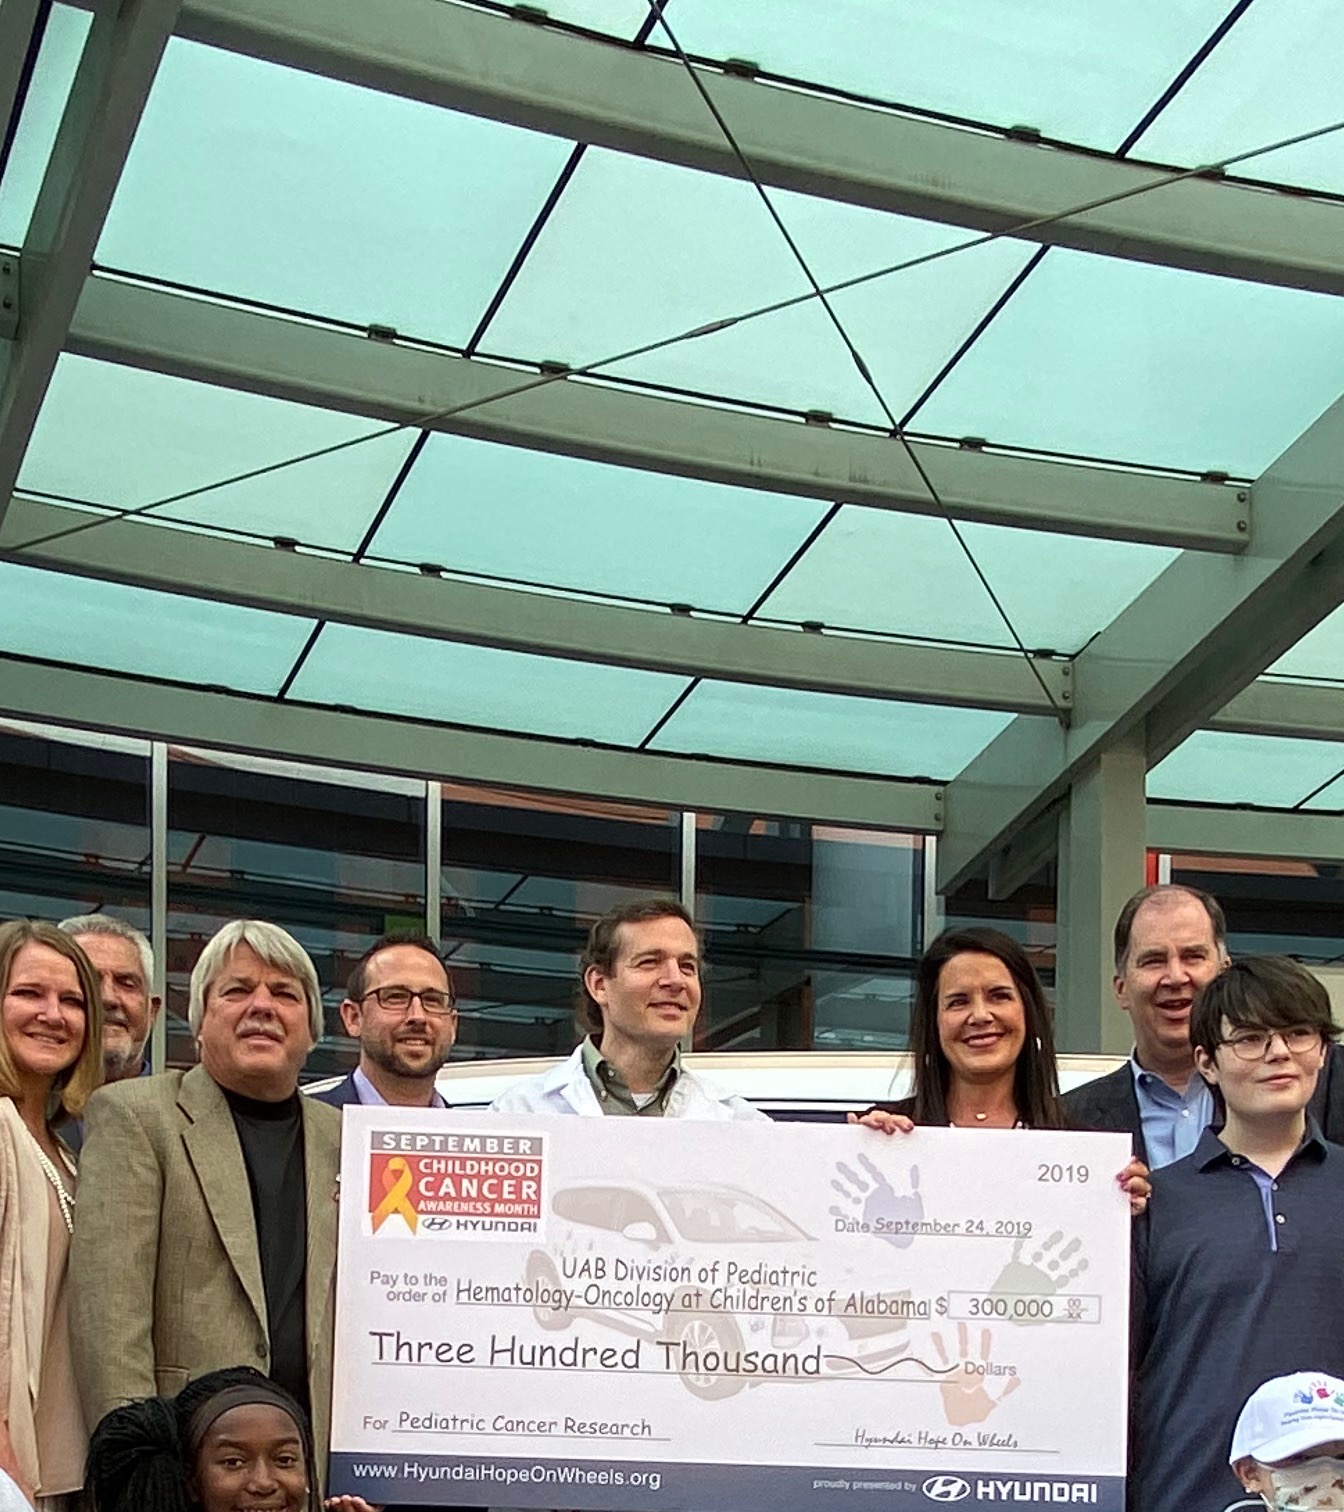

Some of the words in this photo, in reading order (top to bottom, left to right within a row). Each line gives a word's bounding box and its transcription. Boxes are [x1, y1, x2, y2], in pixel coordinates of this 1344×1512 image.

[382, 1134, 533, 1155] SEPTEMBER
[418, 1157, 539, 1178] CHILDHOOD
[1036, 1164, 1090, 1184] 2019
[418, 1177, 538, 1200] CANCER
[417, 1199, 492, 1214] AWARENESS
[493, 1201, 538, 1216] MONTH
[455, 1218, 538, 1234] HYUNDAI
[834, 1218, 870, 1234] Date
[874, 1218, 960, 1236] September
[964, 1219, 990, 1236] 24,
[994, 1220, 1033, 1237] 2019
[369, 1270, 400, 1290] Pay
[403, 1272, 420, 1287] to
[423, 1273, 449, 1288] the
[562, 1257, 608, 1280] UAB
[614, 1258, 691, 1284] Division
[697, 1260, 720, 1285] of
[726, 1262, 818, 1288] Pediatric
[386, 1288, 429, 1303] order
[432, 1289, 449, 1303] of
[456, 1277, 676, 1314] Hematology-Oncology
[680, 1288, 703, 1309] at
[709, 1288, 808, 1314] Children's
[814, 1290, 837, 1314] of
[843, 1292, 929, 1317] Alabama
[935, 1294, 948, 1316] $
[968, 1297, 1054, 1321] 300,000
[368, 1330, 476, 1365] Three
[488, 1333, 641, 1370] Hundred
[655, 1339, 822, 1376] Thousand
[963, 1360, 1018, 1377] Dollars
[362, 1415, 390, 1432] For
[398, 1411, 486, 1432] Pediatric
[492, 1415, 558, 1434] Cancer
[563, 1416, 652, 1437] Research
[854, 1429, 913, 1448] Hyundai
[917, 1431, 949, 1449] Hope
[951, 1432, 973, 1447] On
[976, 1432, 1018, 1449] Wheels
[352, 1461, 662, 1490] www.HyundaiHopeOnWheels.org
[812, 1478, 851, 1492] proudly
[852, 1480, 902, 1493] presented
[904, 1480, 917, 1493] by
[976, 1479, 1098, 1503] HYUNDAI
